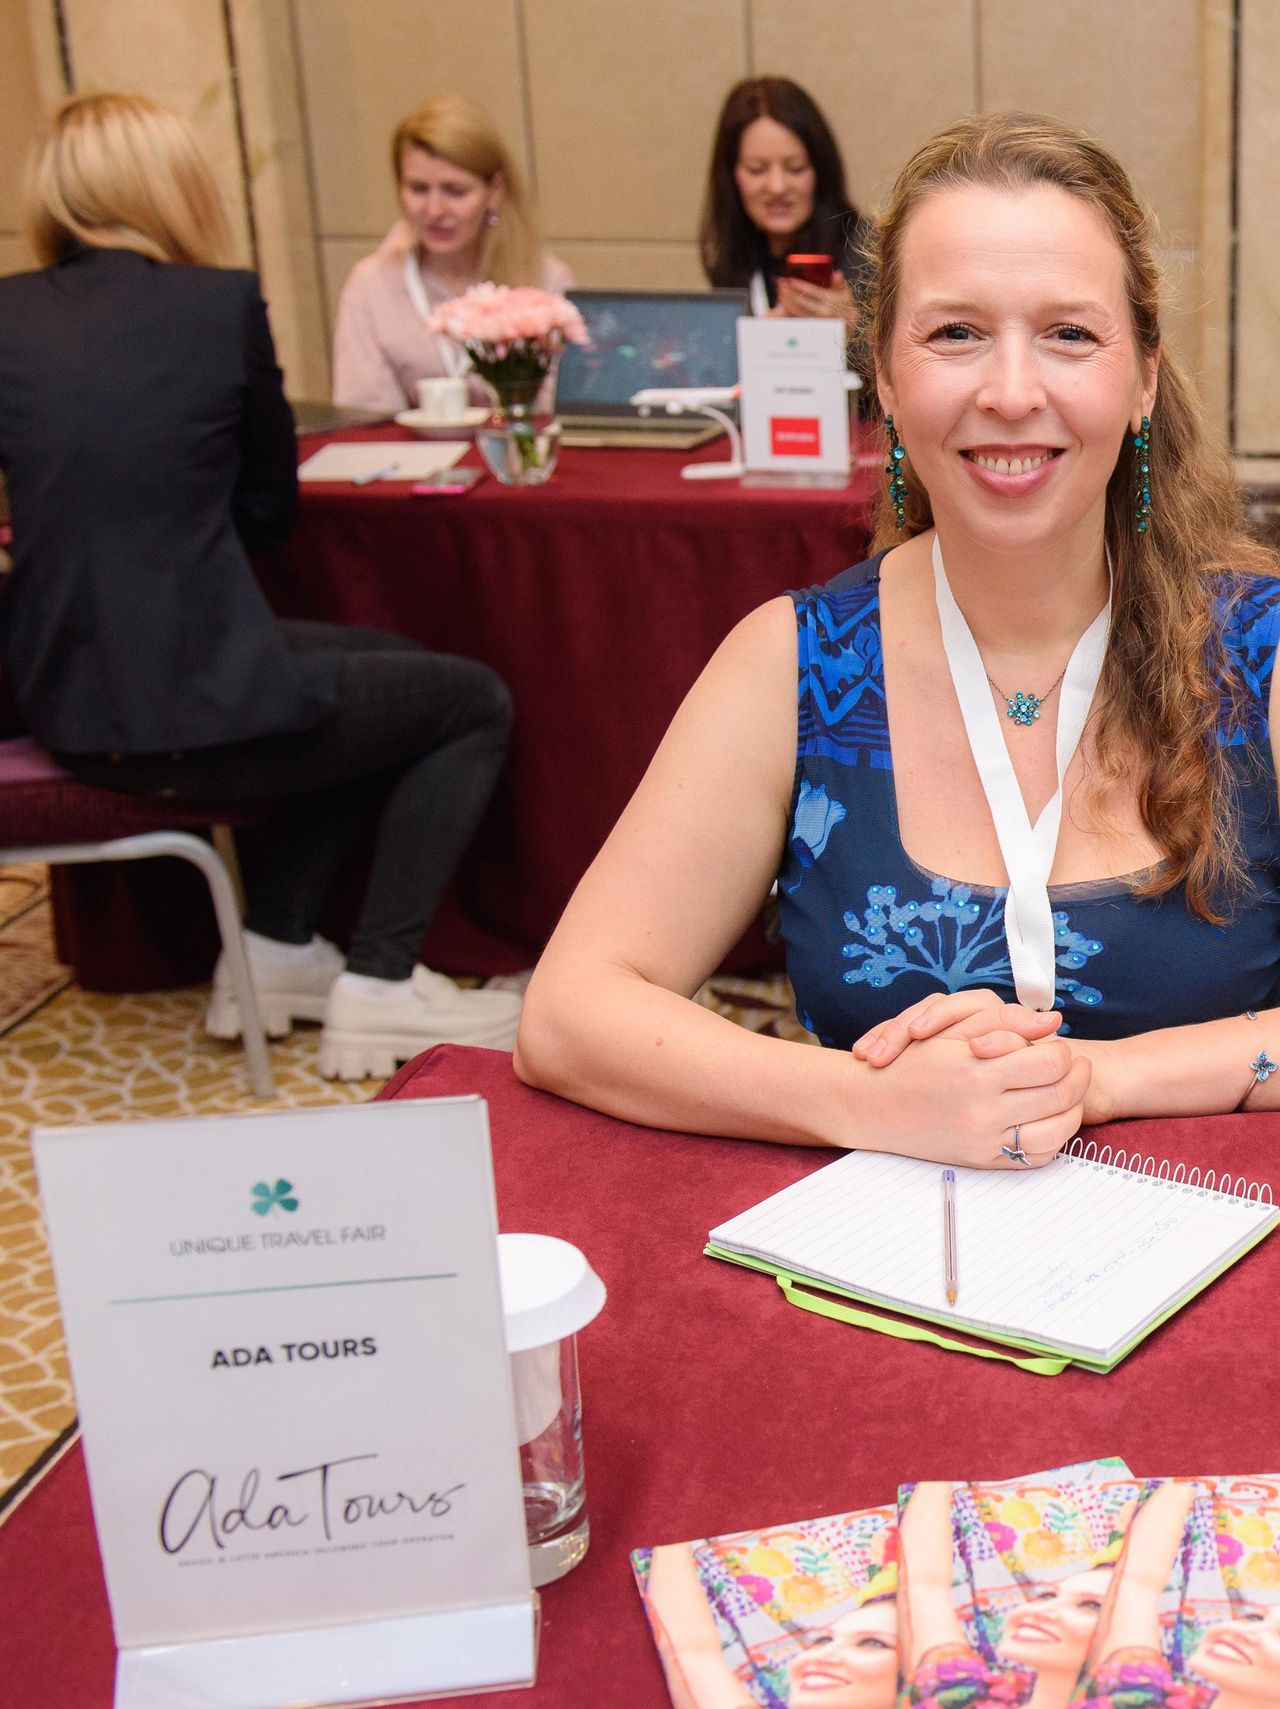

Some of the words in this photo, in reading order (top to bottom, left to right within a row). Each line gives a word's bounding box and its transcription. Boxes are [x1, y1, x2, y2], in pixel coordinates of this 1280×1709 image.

[168, 1234, 254, 1258] UNIQUE
[260, 1228, 336, 1249] TRAVEL
[341, 1224, 387, 1243] FAIR
[211, 1346, 274, 1370] ADA
[281, 1336, 378, 1363] TOURS
